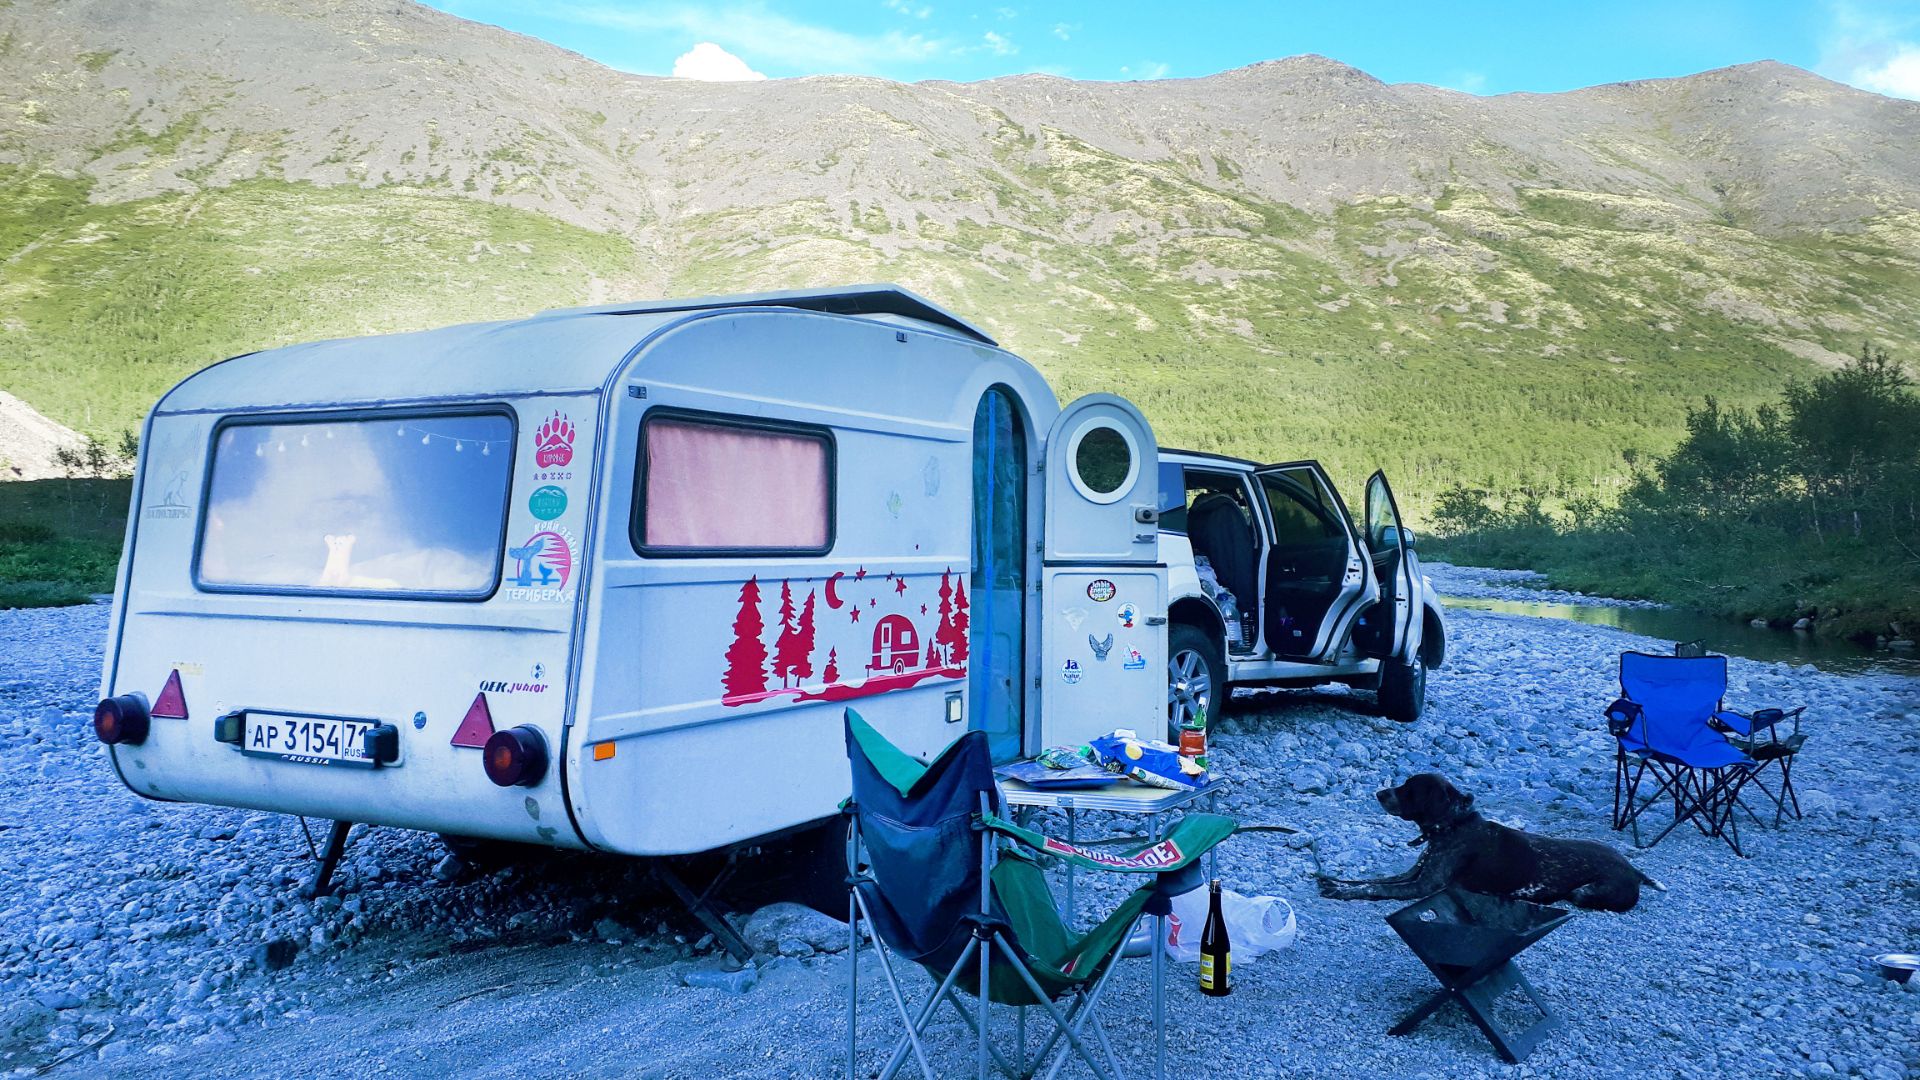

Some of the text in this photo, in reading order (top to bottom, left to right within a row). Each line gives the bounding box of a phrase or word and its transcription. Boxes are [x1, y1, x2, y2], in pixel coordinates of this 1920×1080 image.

[505, 588, 575, 602] ТЕРИБЕРКА
[284, 720, 339, 755] 3154
[344, 748, 361, 758] RUS
[289, 755, 330, 765] RUSSIA
